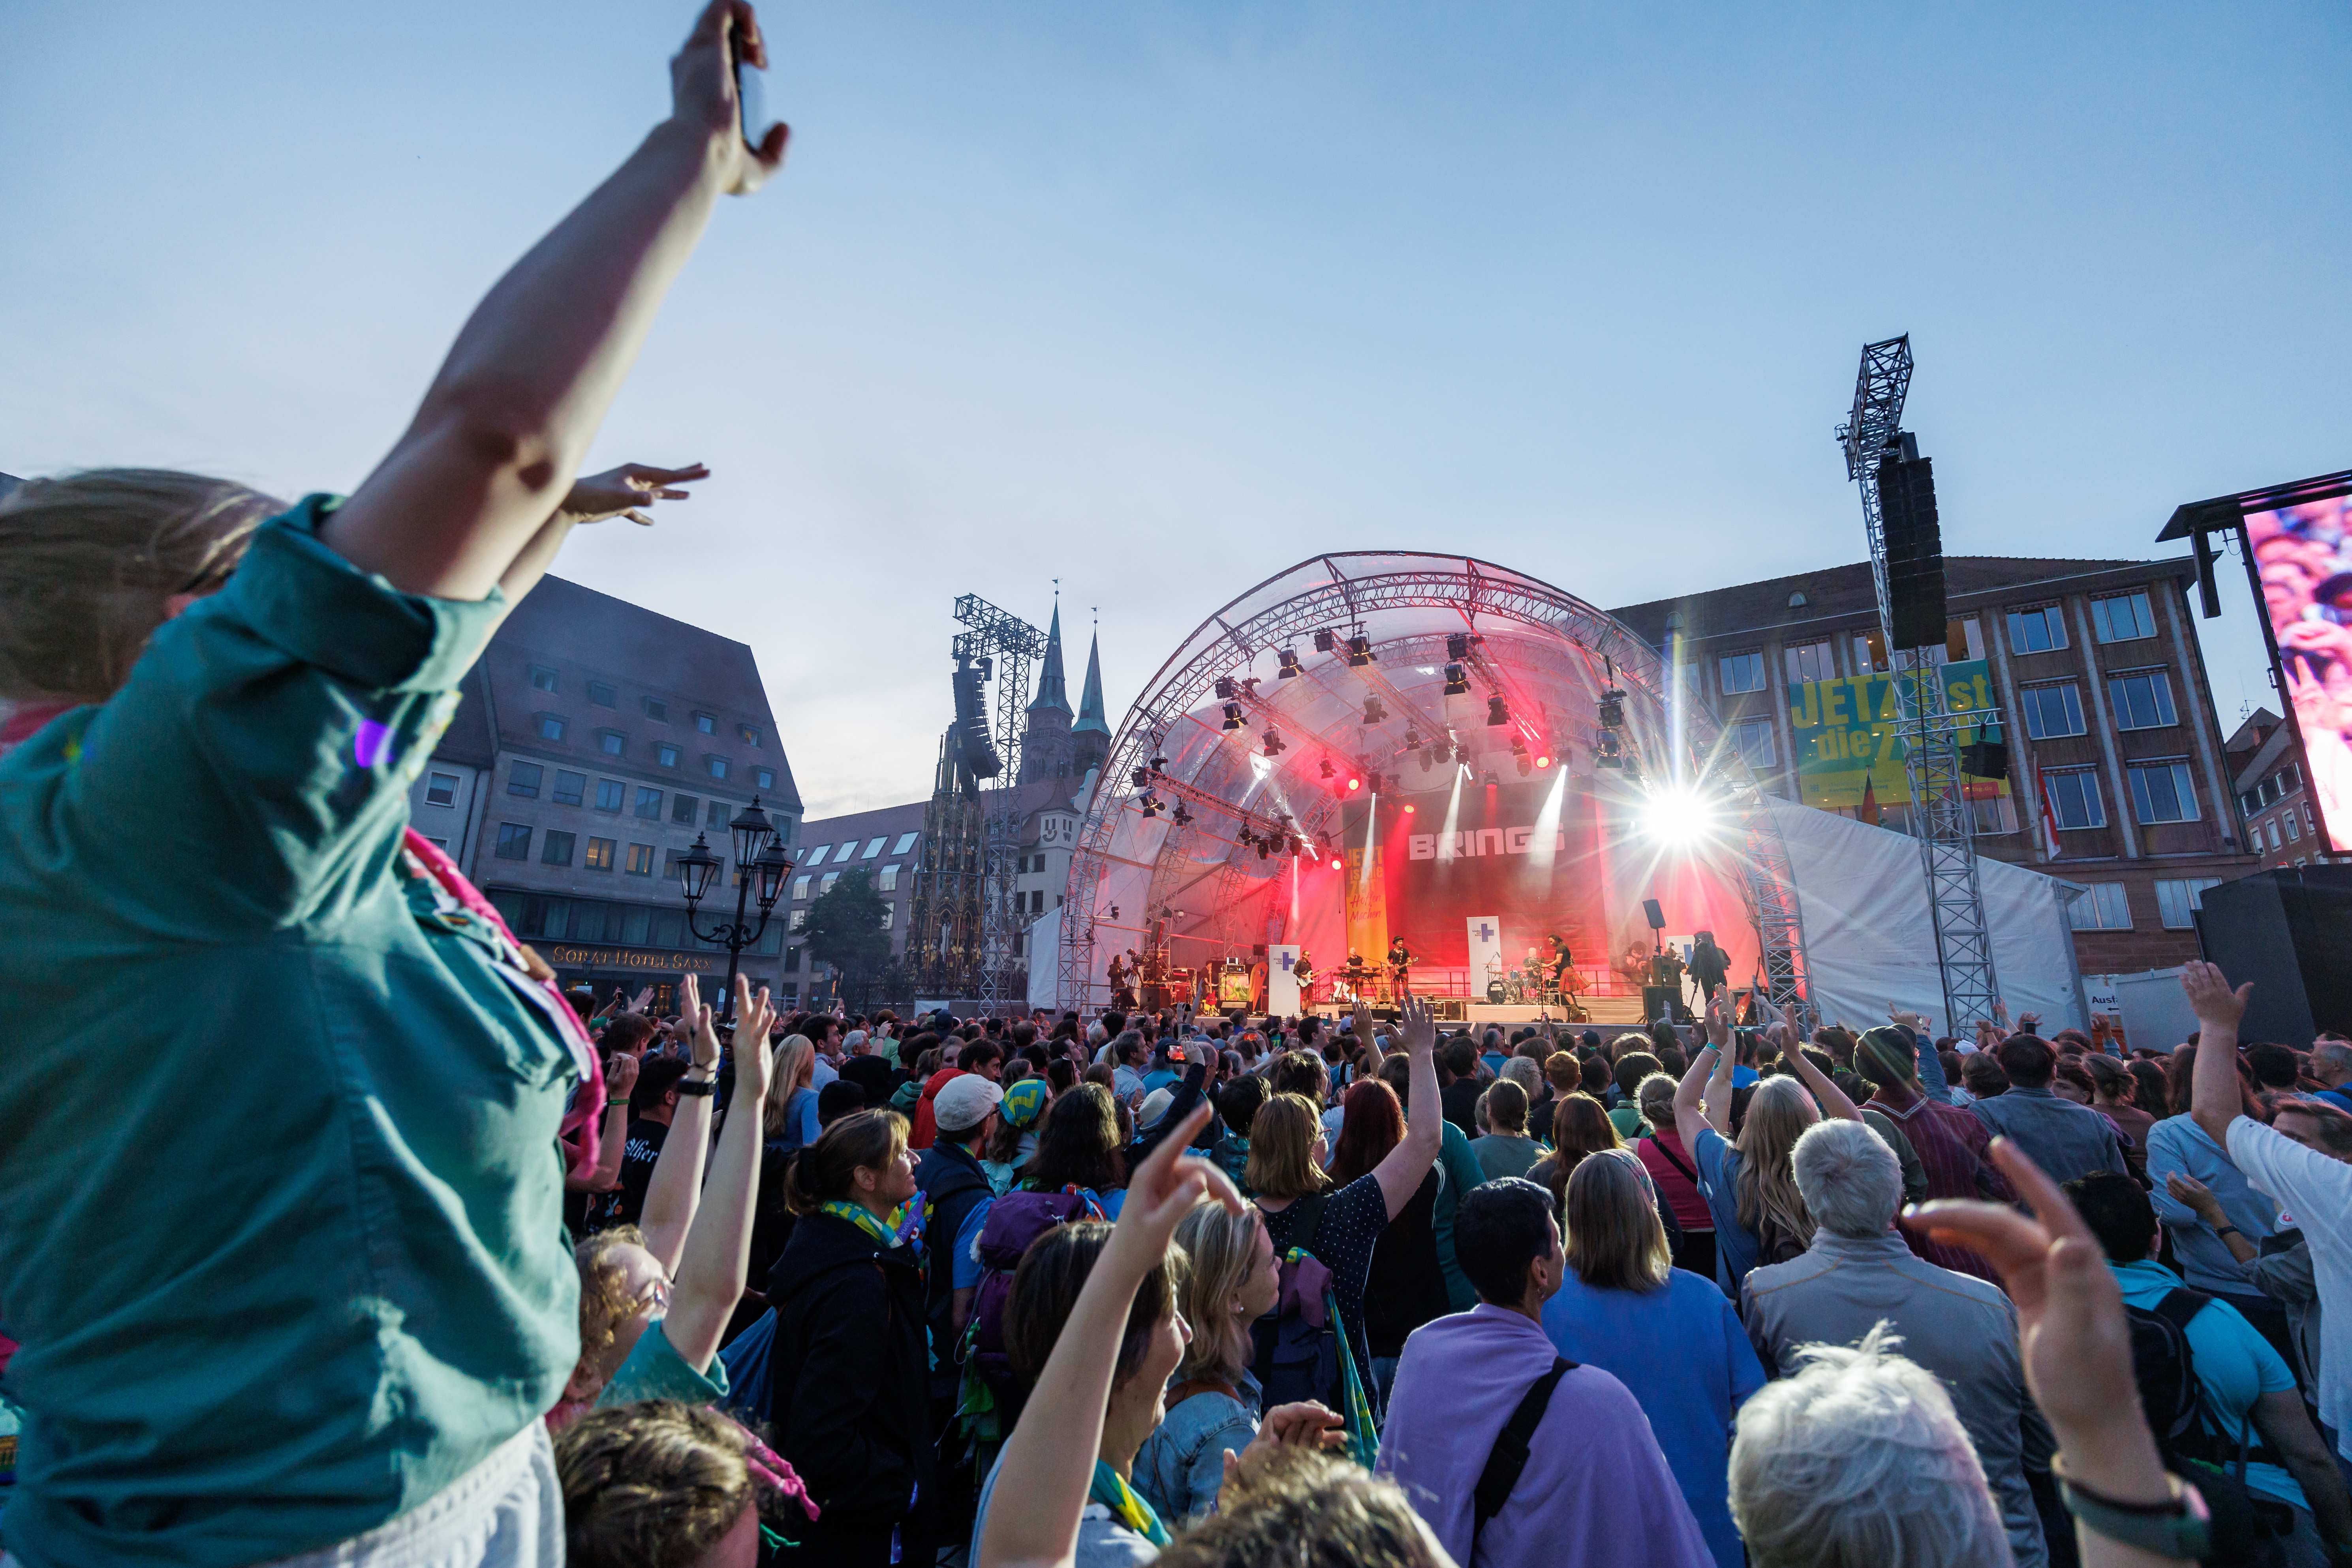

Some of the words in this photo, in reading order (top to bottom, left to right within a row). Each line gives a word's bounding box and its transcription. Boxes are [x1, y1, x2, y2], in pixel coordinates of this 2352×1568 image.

[1938, 674, 1990, 711] st
[1818, 726, 1871, 761] die
[1409, 822, 1565, 860] BRINGS
[553, 946, 611, 963] SORAT
[616, 950, 669, 968] HOTEL
[673, 954, 712, 970] SAXX
